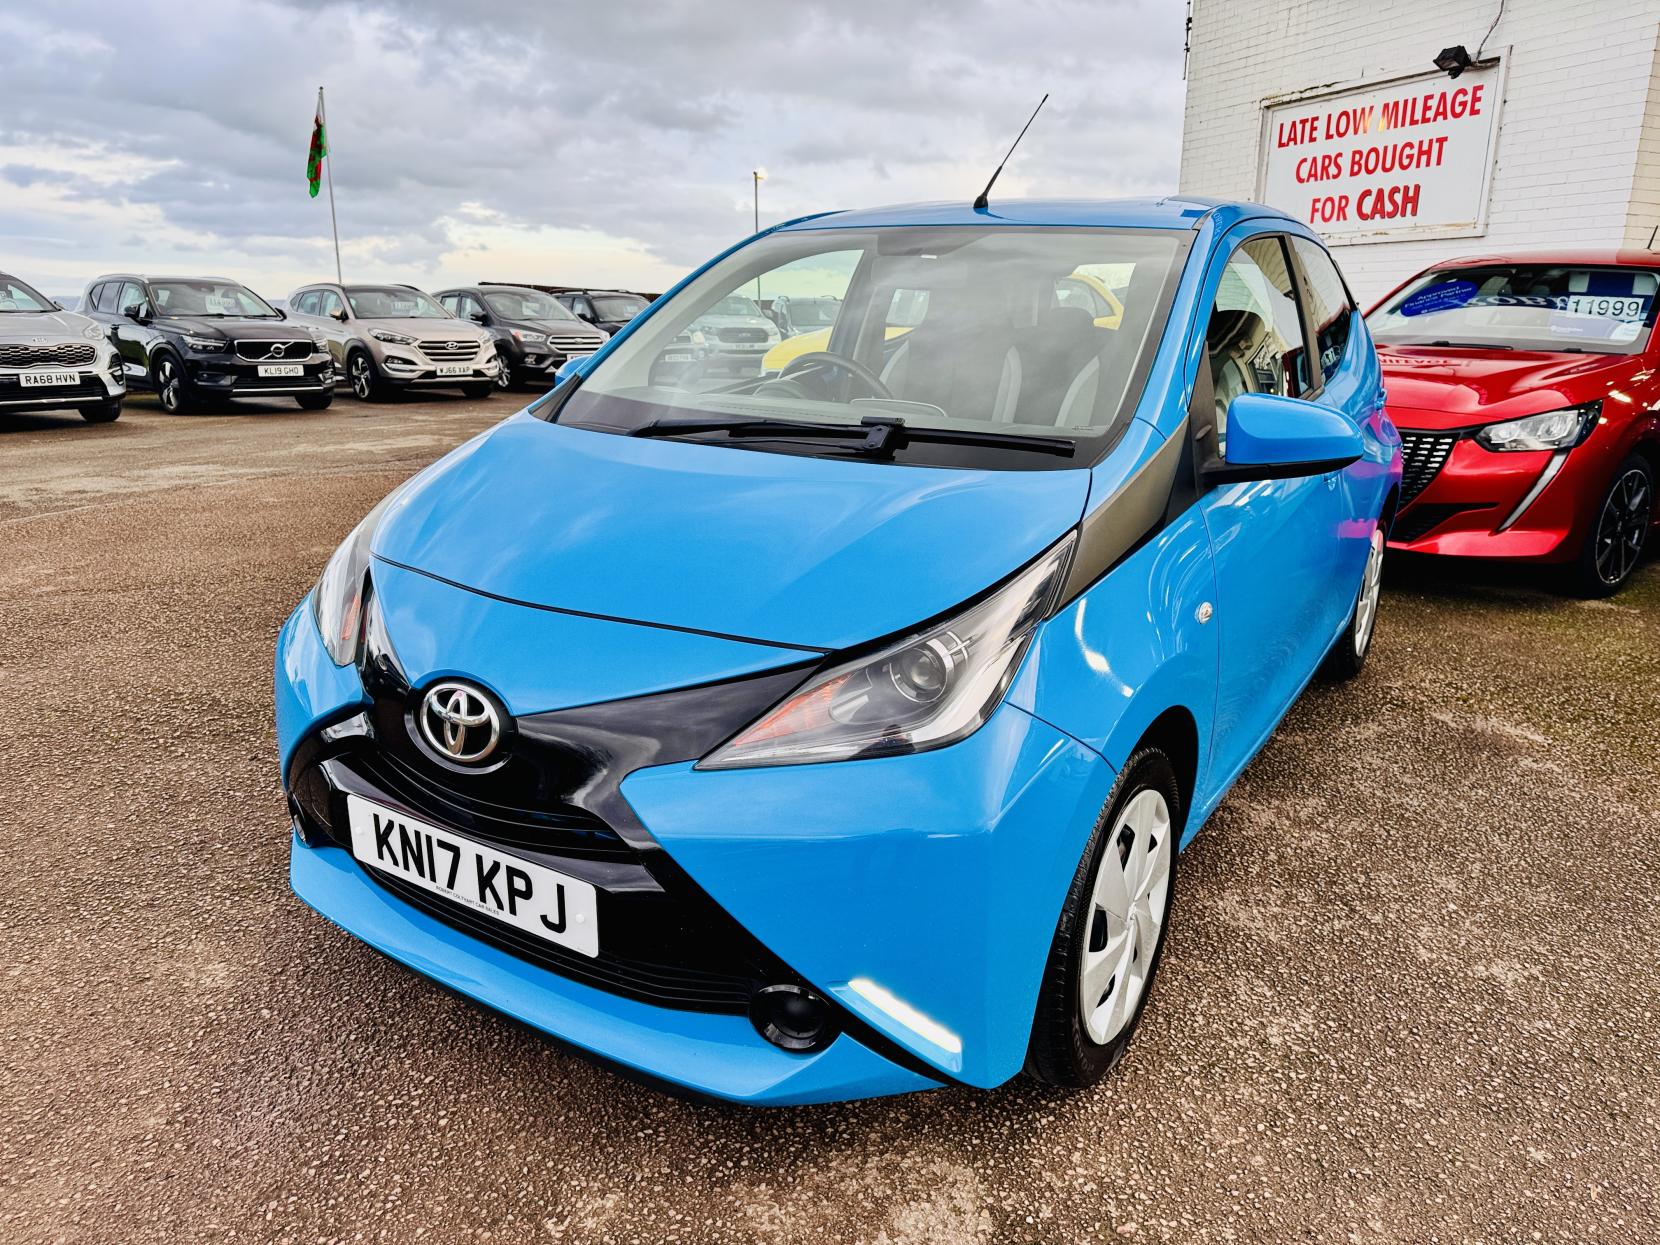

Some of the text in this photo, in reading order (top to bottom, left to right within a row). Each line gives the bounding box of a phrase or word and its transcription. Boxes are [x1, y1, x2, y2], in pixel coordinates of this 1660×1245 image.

[1277, 84, 1485, 149] LATE LOW MILEAGE
[1295, 136, 1449, 184] CARS BOUGHT
[1309, 183, 1421, 225] FOR CASH
[24, 373, 76, 385] RA68 HVN
[373, 813, 567, 934] KN17 KPJ
